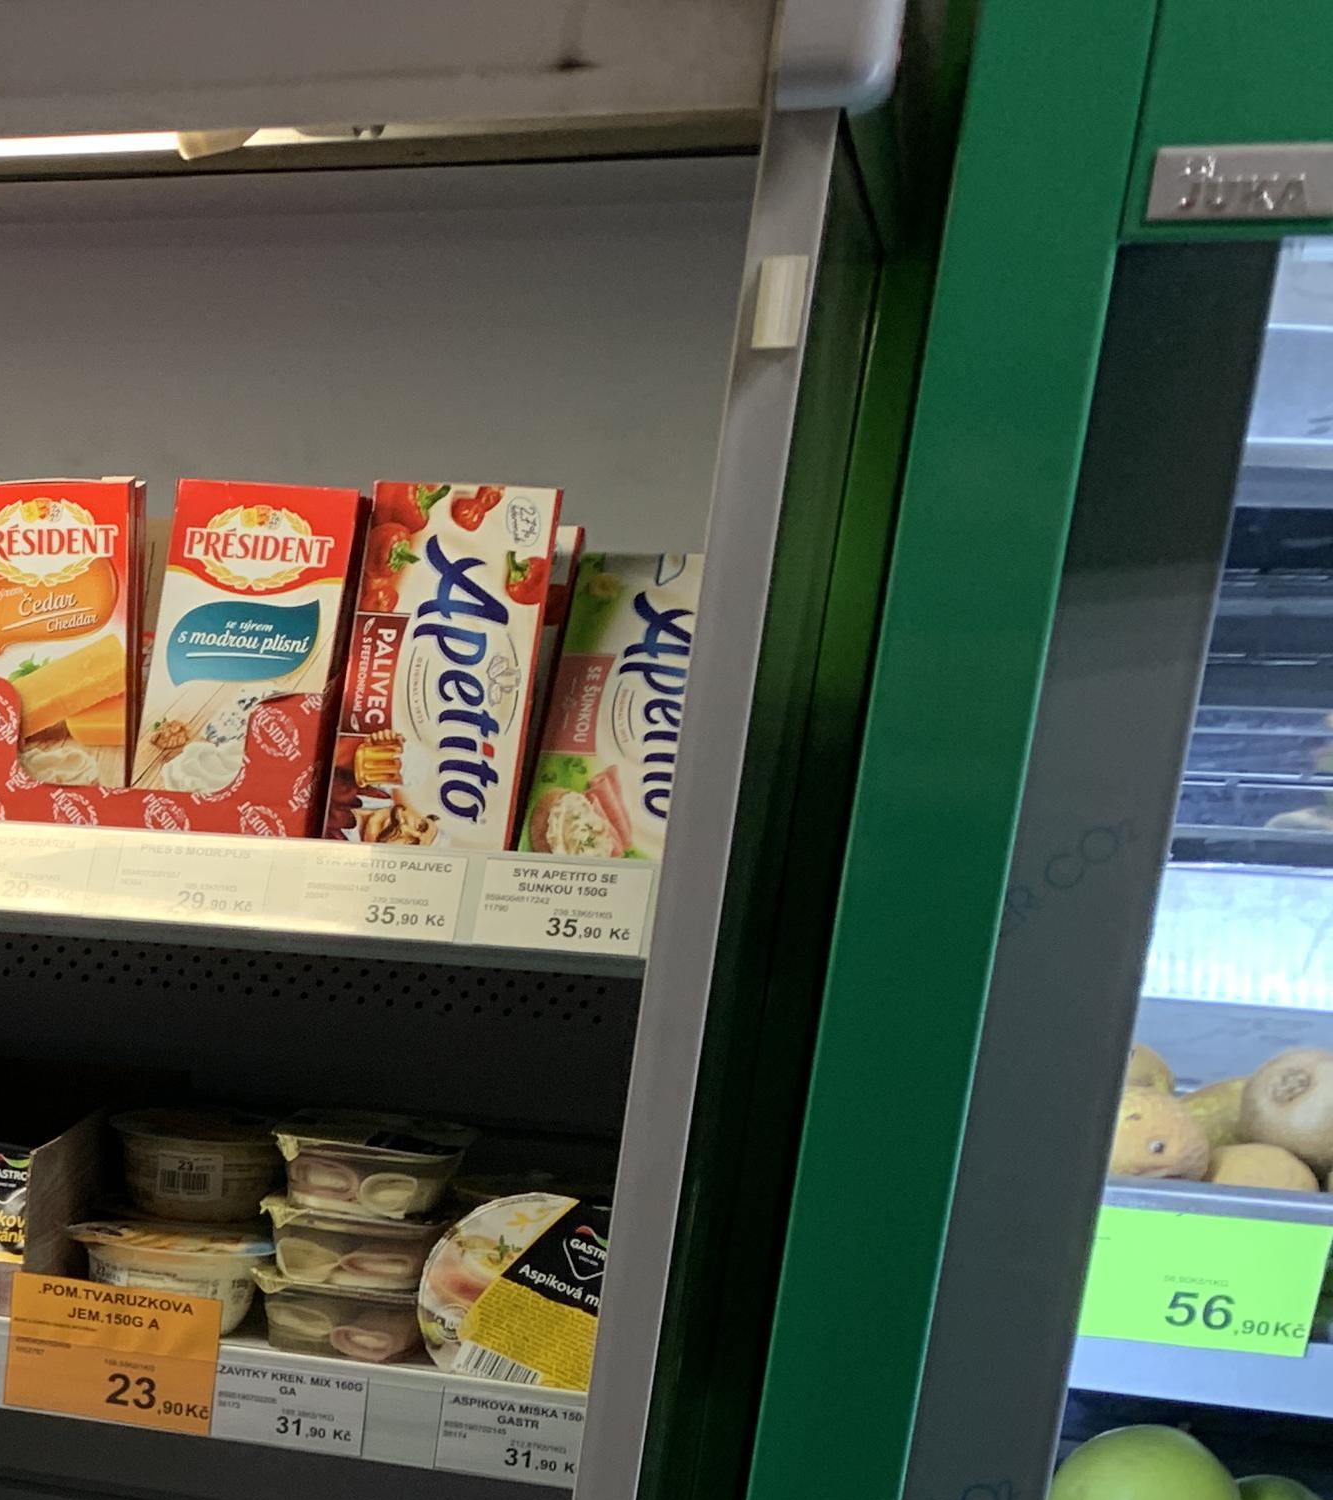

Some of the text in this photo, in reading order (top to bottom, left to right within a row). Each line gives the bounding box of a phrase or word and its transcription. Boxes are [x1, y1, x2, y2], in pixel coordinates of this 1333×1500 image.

[184, 528, 333, 567] PRÉSIDENT
[18, 590, 78, 618] Čedar
[46, 612, 98, 633] Cheddar
[179, 629, 310, 654] s modrou plísní
[365, 628, 395, 726] PALIVEC
[416, 534, 509, 825] Apetito
[341, 858, 453, 874] APETITO PALIVEC
[367, 873, 396, 883] 150G
[513, 867, 618, 884] SYR APETITO SE
[518, 883, 608, 897] SUNKOU 150G
[365, 904, 445, 928] 35,90 Kč
[546, 917, 630, 941] 35,90 Kč
[37, 1281, 194, 1316] .POM.TVARUZKOVA
[67, 1306, 160, 1331] JEM.150G A
[1163, 1289, 1306, 1340] 56,90 Kč
[105, 1372, 209, 1420] 23,90 Kč
[279, 1386, 297, 1398] GA
[275, 1415, 352, 1442] 31,90 Kč
[497, 1414, 539, 1431] GASTR
[503, 1446, 557, 1472] 31,90
